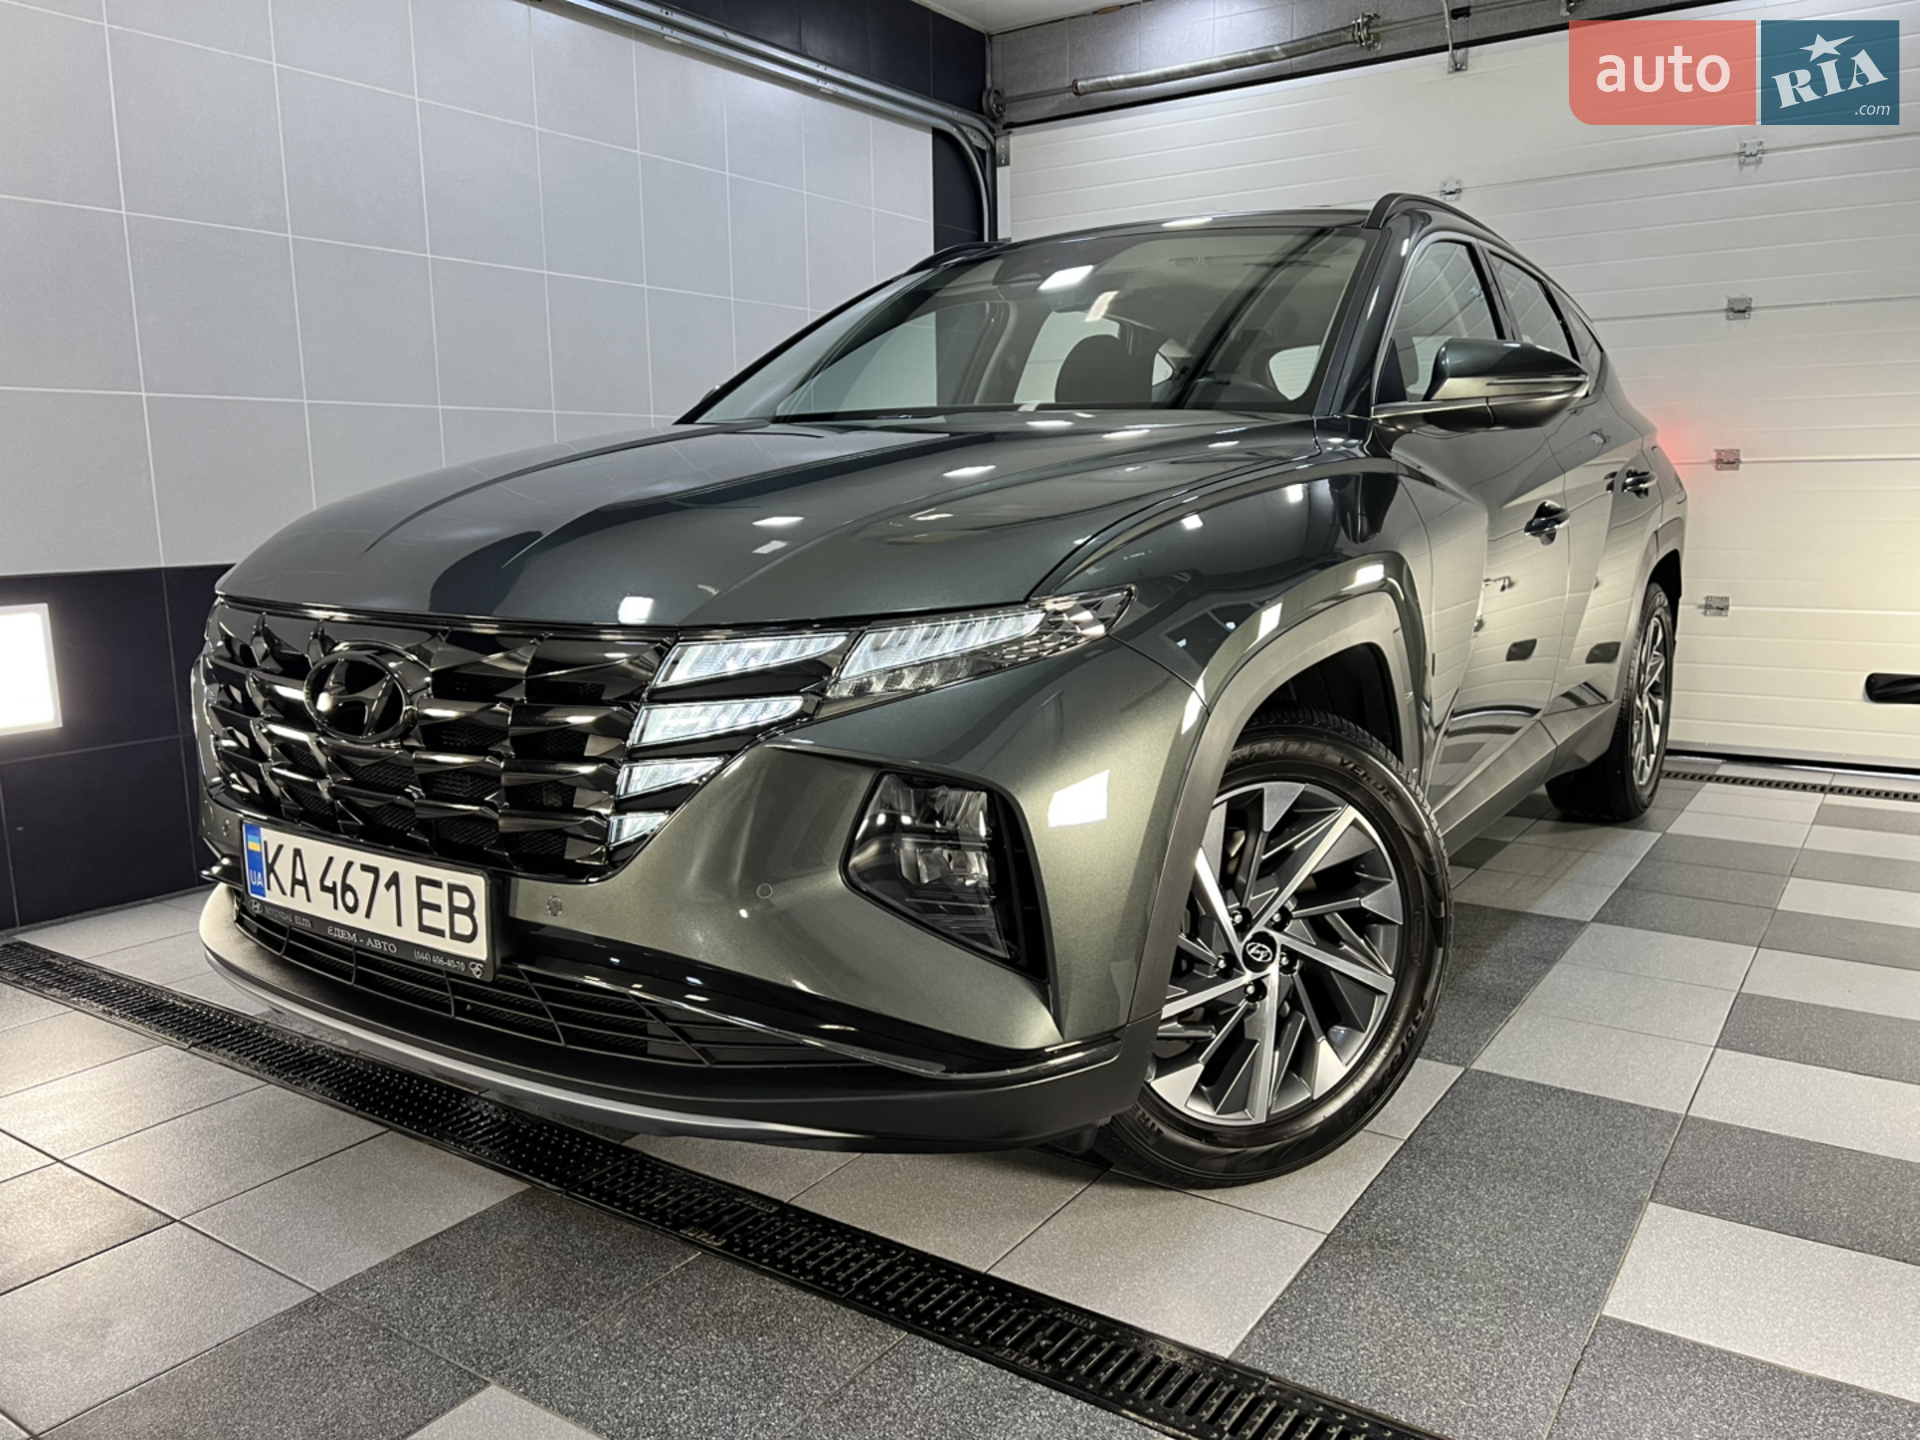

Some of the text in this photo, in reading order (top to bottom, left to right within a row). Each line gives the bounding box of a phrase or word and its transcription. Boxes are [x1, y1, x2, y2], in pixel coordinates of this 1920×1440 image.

[250, 869, 264, 887] UA
[263, 839, 479, 944] KA 4671 EB
